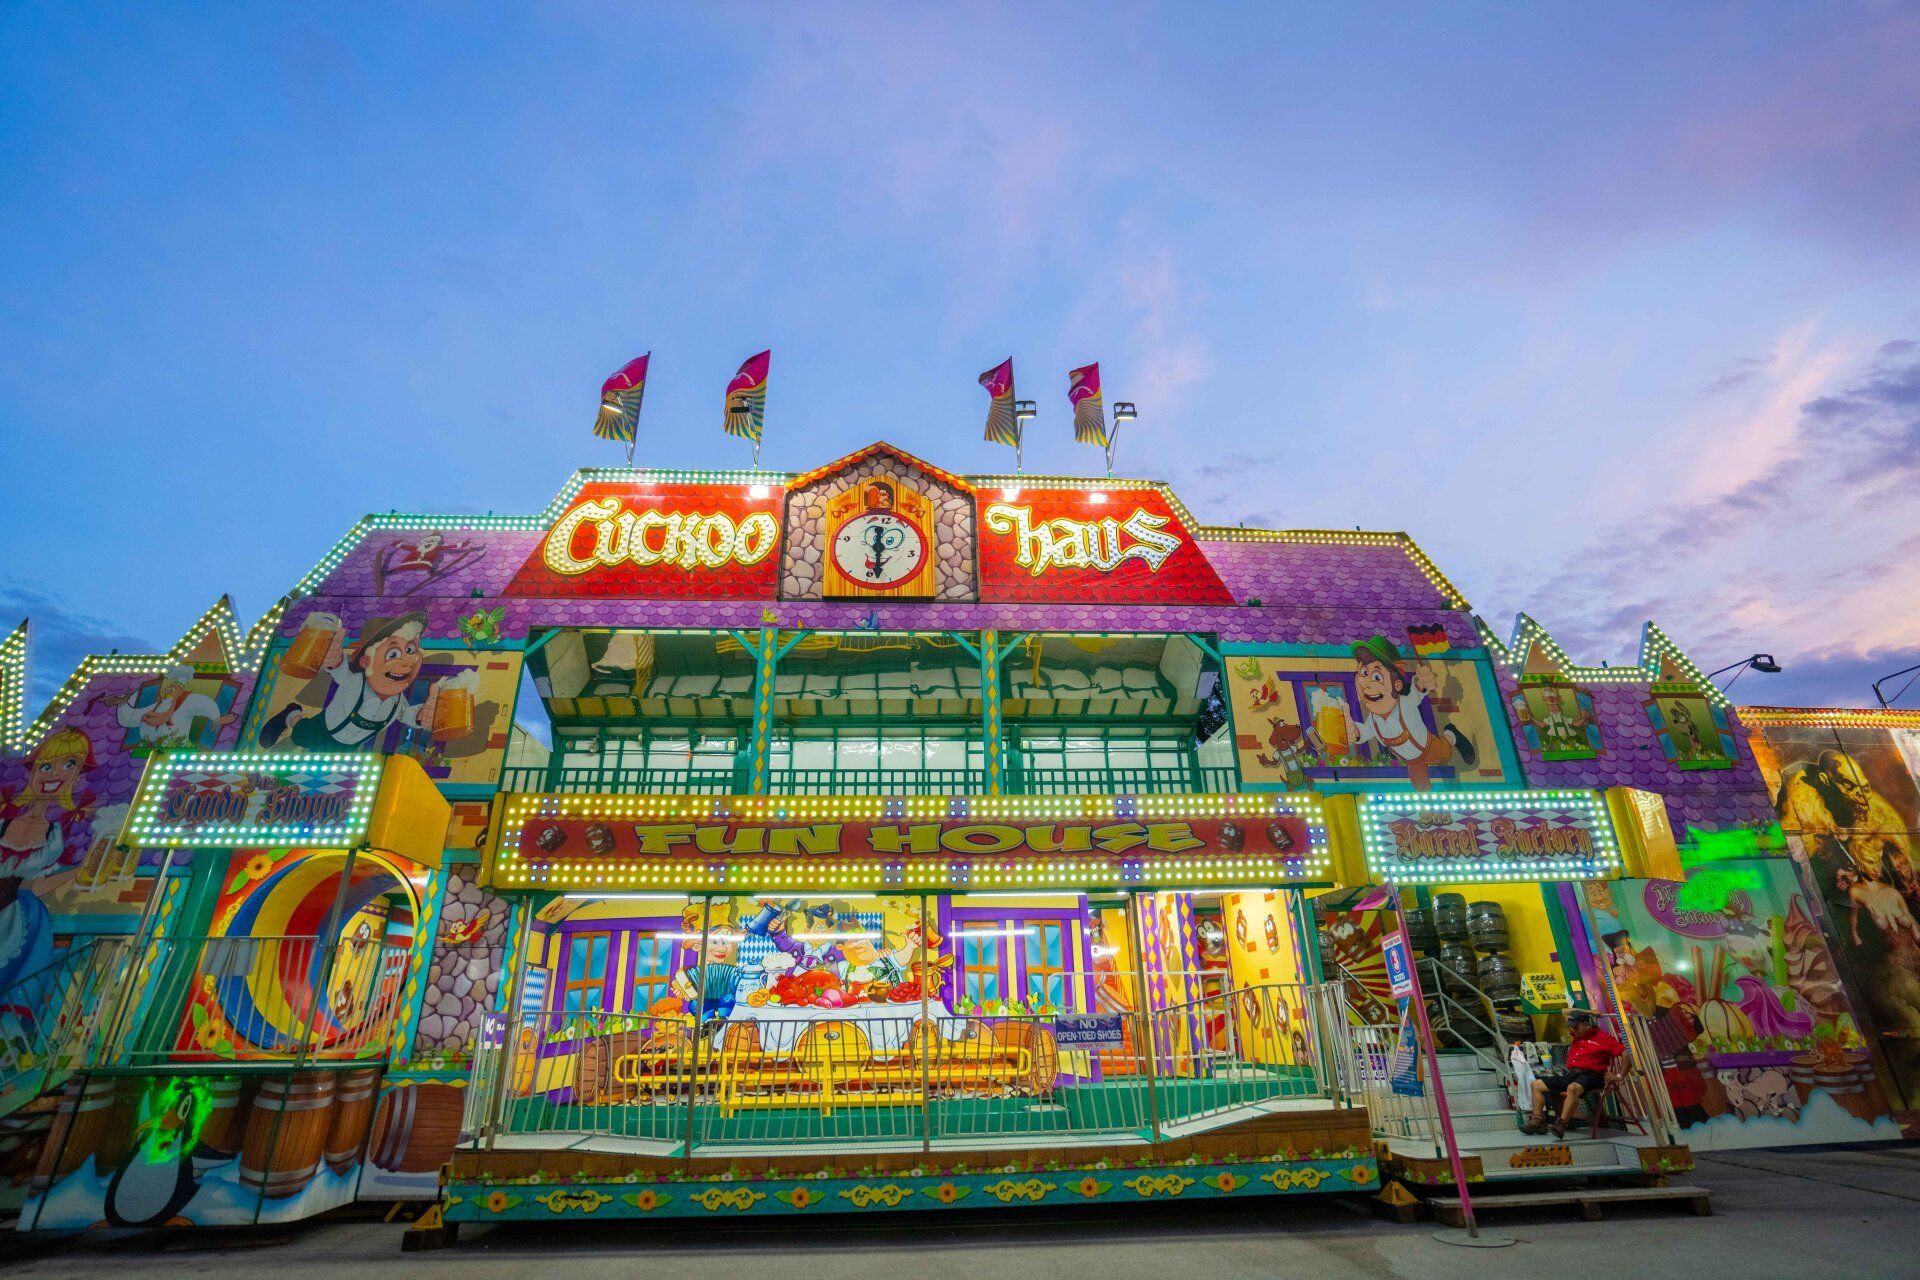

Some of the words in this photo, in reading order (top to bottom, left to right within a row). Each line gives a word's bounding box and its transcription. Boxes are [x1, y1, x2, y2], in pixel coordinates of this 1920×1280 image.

[881, 517, 892, 525] 12
[907, 550, 915, 558] 3
[865, 569, 874, 577] 6
[163, 784, 249, 825] Candy
[255, 785, 349, 826] Shoppe
[1417, 811, 1453, 828] Das
[634, 823, 844, 855] FUN
[869, 822, 1206, 854] HOUSE
[1388, 821, 1482, 864] Barrel
[1491, 819, 1595, 862] Factory
[1079, 1018, 1098, 1029] NO
[1057, 1031, 1096, 1041] OPEN-TOED
[1097, 1029, 1121, 1040] SHOES
